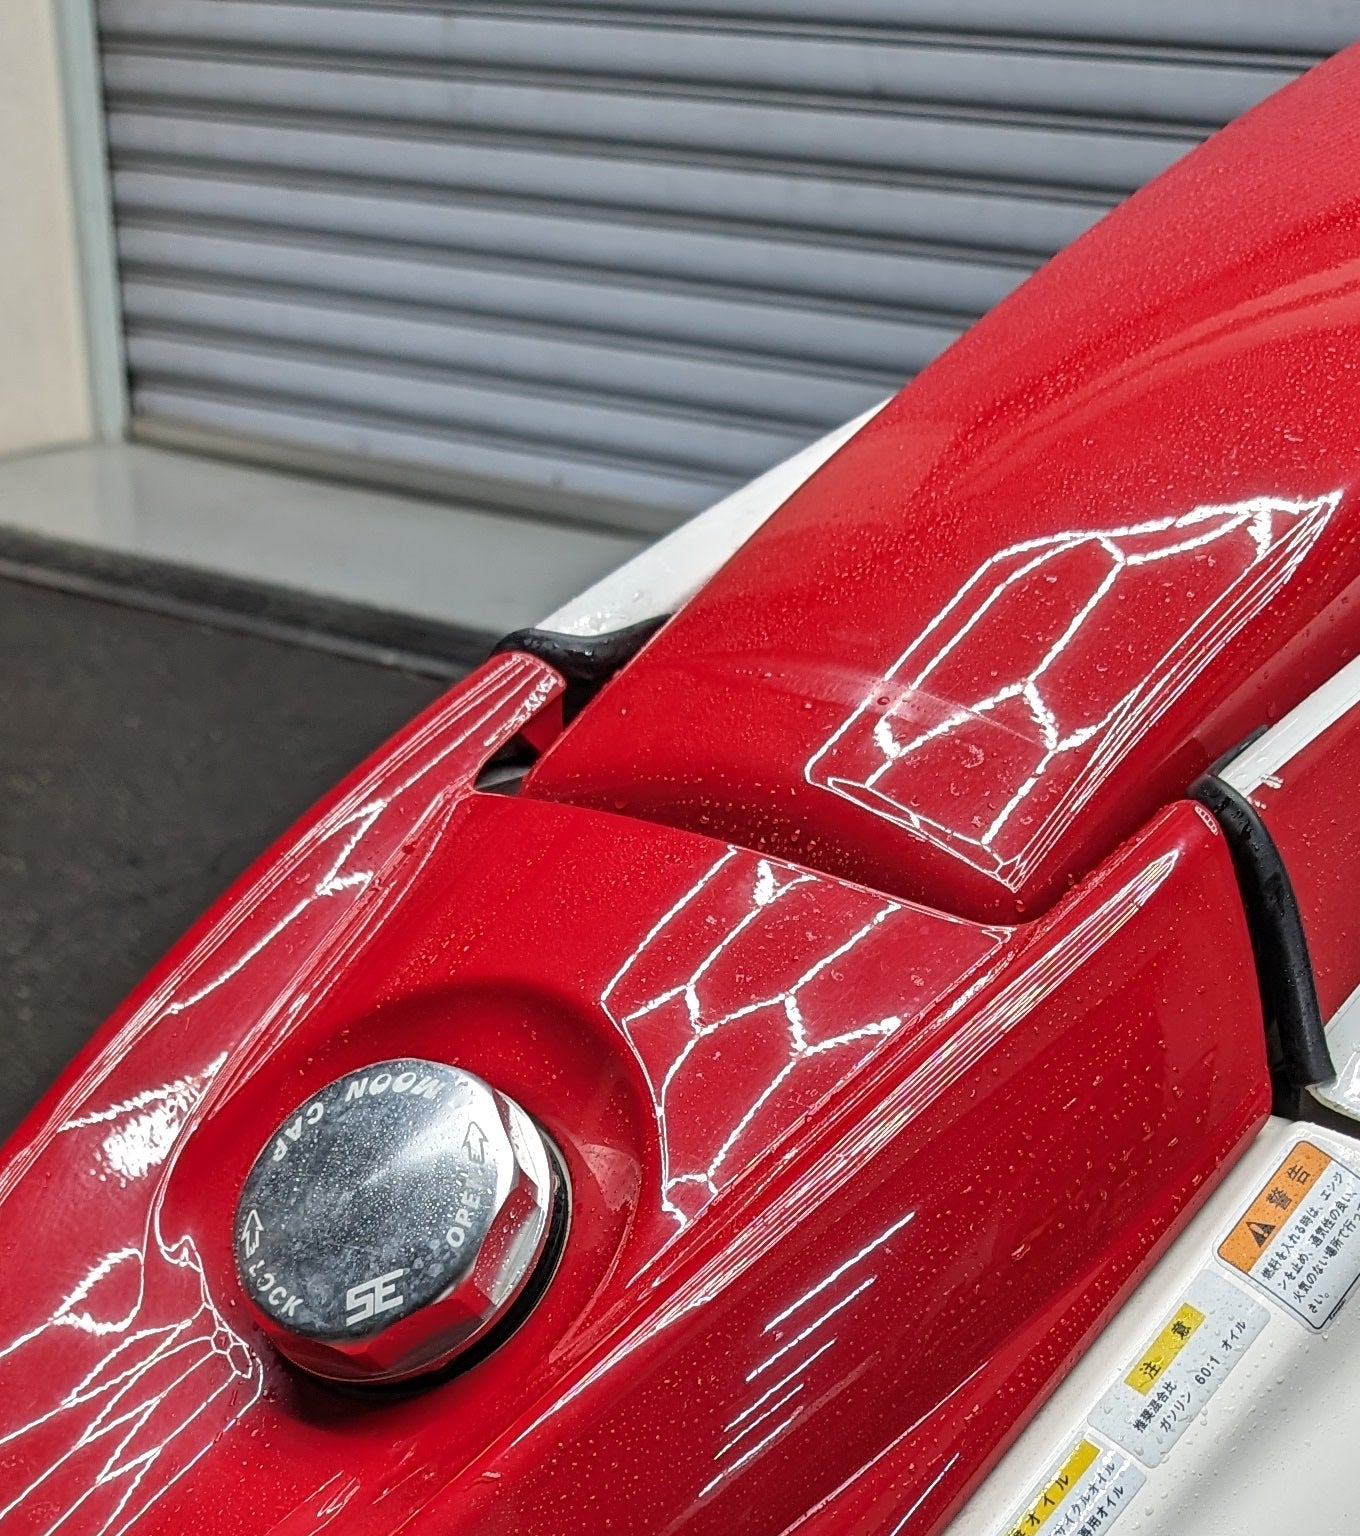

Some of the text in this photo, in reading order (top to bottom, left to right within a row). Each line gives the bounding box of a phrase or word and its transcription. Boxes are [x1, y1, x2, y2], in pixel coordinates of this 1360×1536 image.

[273, 1072, 445, 1162] MOON CAP
[1266, 1165, 1310, 1210] 警告
[249, 1259, 304, 1317] LOCK
[1140, 1321, 1191, 1379] 注意
[1160, 1321, 1246, 1432] ガソリン 60:1 オイル
[1133, 1381, 1177, 1433] 推奨混合比
